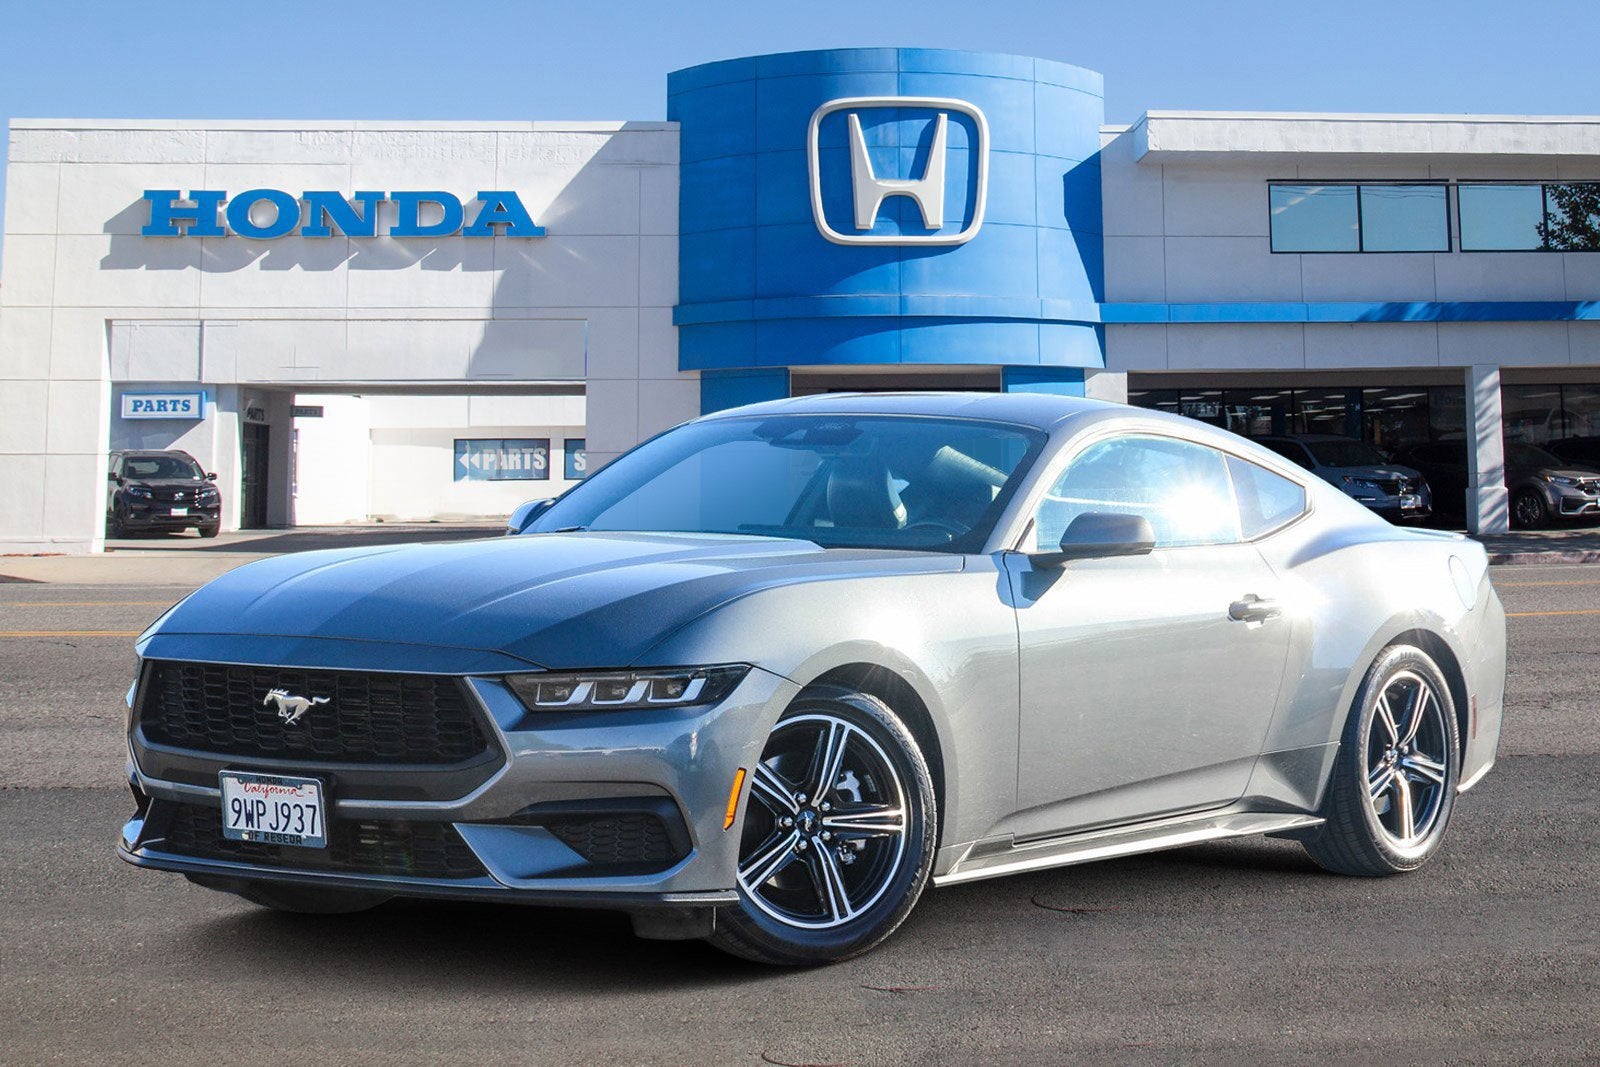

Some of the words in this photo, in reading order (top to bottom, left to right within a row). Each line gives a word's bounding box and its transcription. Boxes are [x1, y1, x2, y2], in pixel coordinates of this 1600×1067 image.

[142, 188, 547, 240] HONDA
[132, 399, 191, 413] PARTS
[482, 448, 546, 471] PARTS
[243, 782, 304, 799] California
[248, 831, 259, 840] OF
[264, 832, 302, 844] RESEDA
